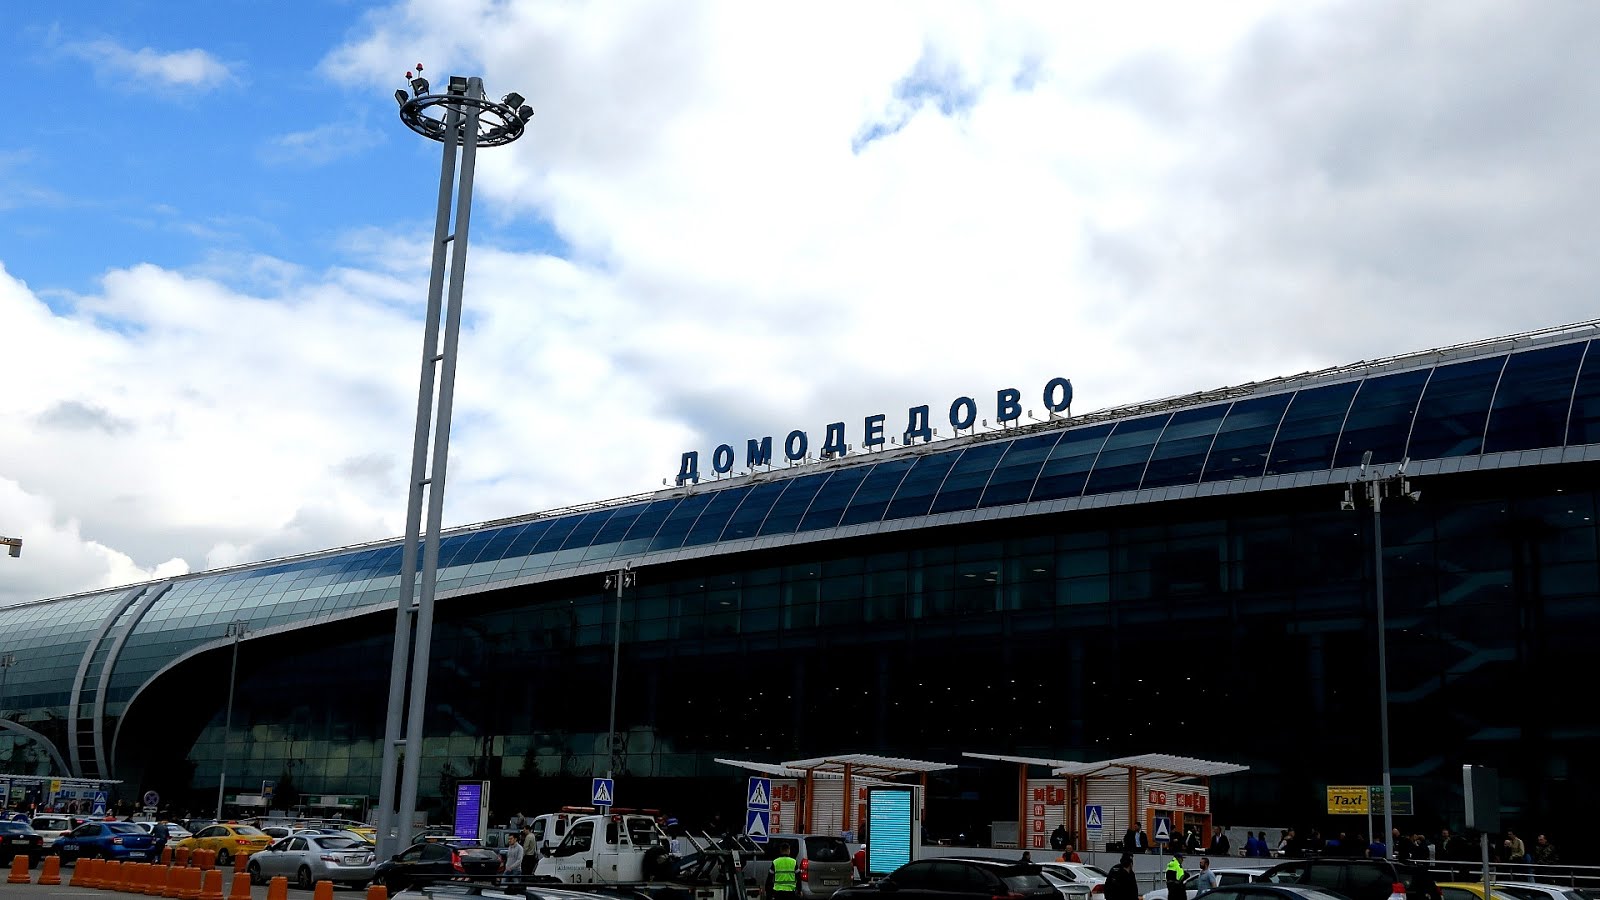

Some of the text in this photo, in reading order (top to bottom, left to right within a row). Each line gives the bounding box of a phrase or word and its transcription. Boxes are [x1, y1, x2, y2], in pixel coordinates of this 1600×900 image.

[675, 377, 1073, 485] ДОМОДЕДОВО
[1333, 794, 1362, 805] Taxi
[570, 873, 582, 883] 13
